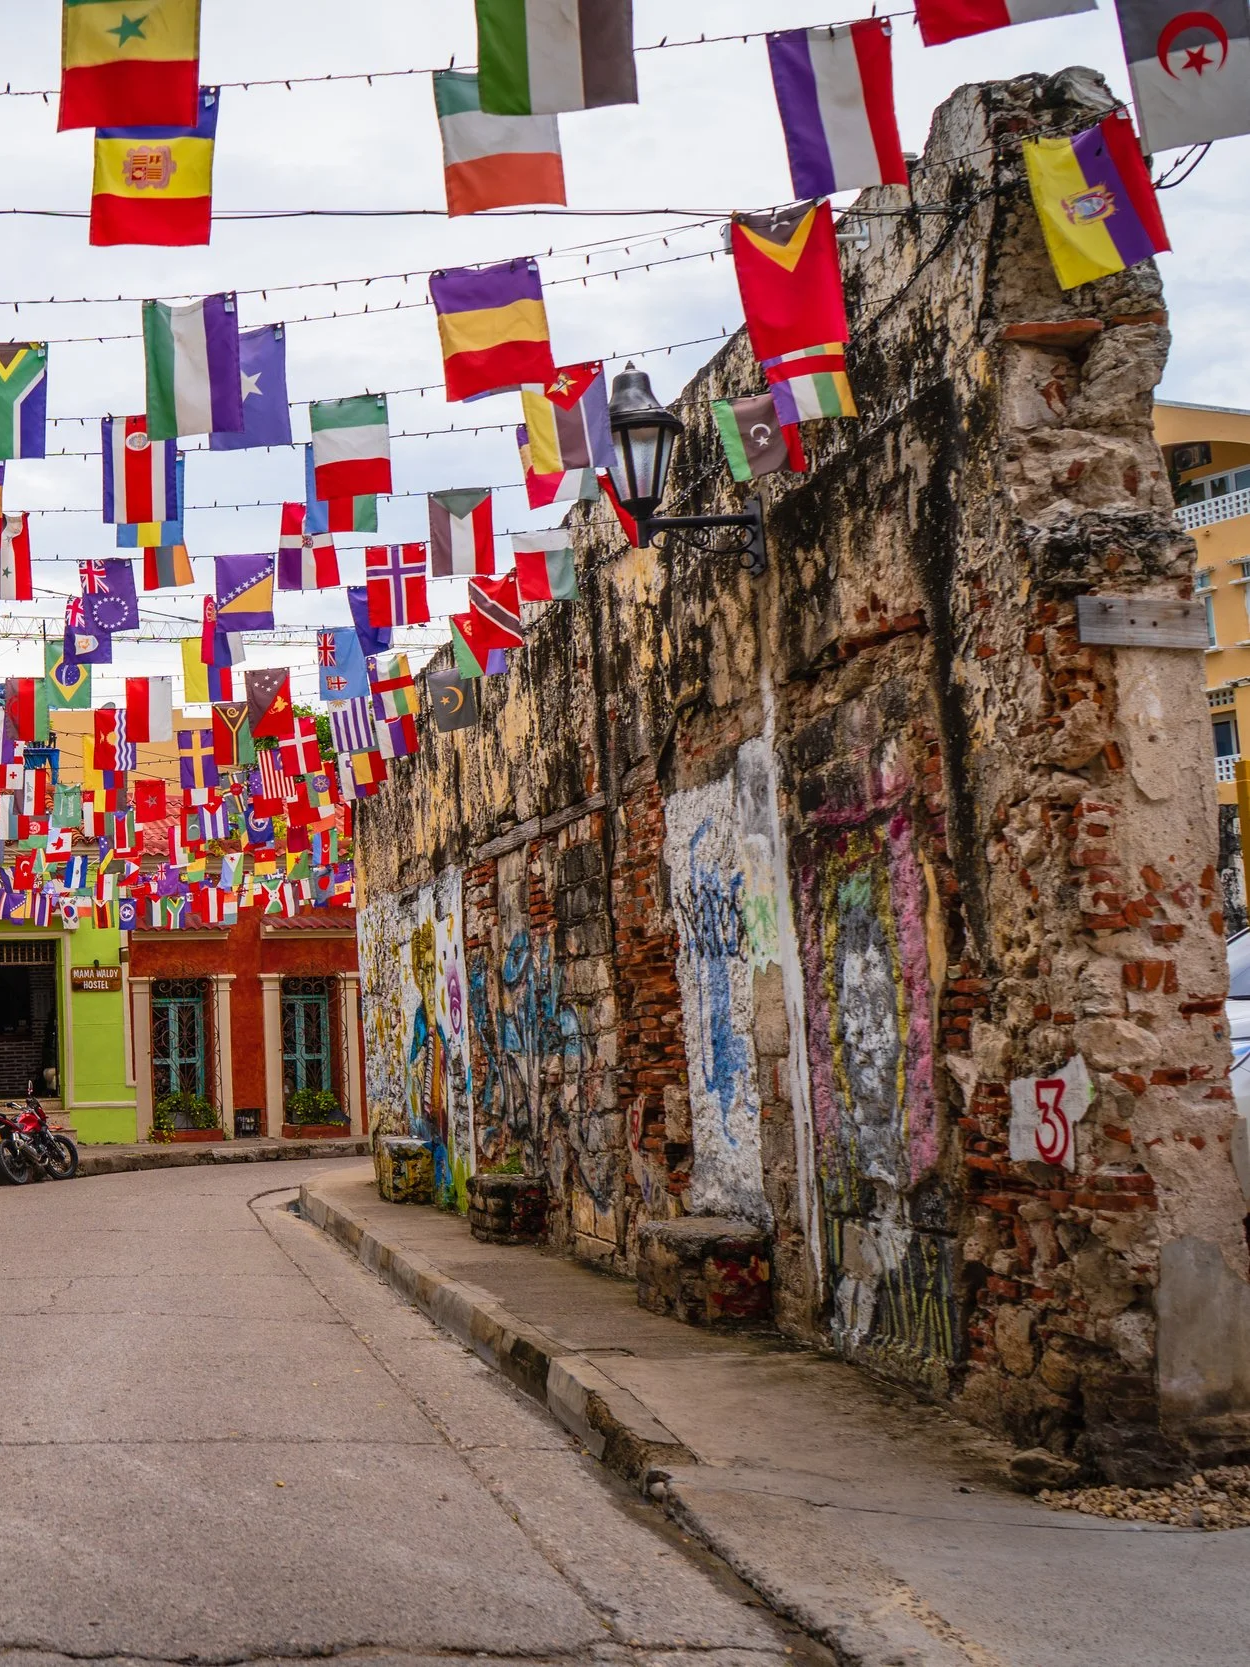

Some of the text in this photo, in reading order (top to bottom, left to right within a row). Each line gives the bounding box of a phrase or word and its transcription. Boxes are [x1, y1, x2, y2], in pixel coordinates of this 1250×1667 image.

[73, 969, 119, 978] MAMA WALDY
[83, 980, 109, 989] HOSTEL
[1035, 1078, 1069, 1164] 3
